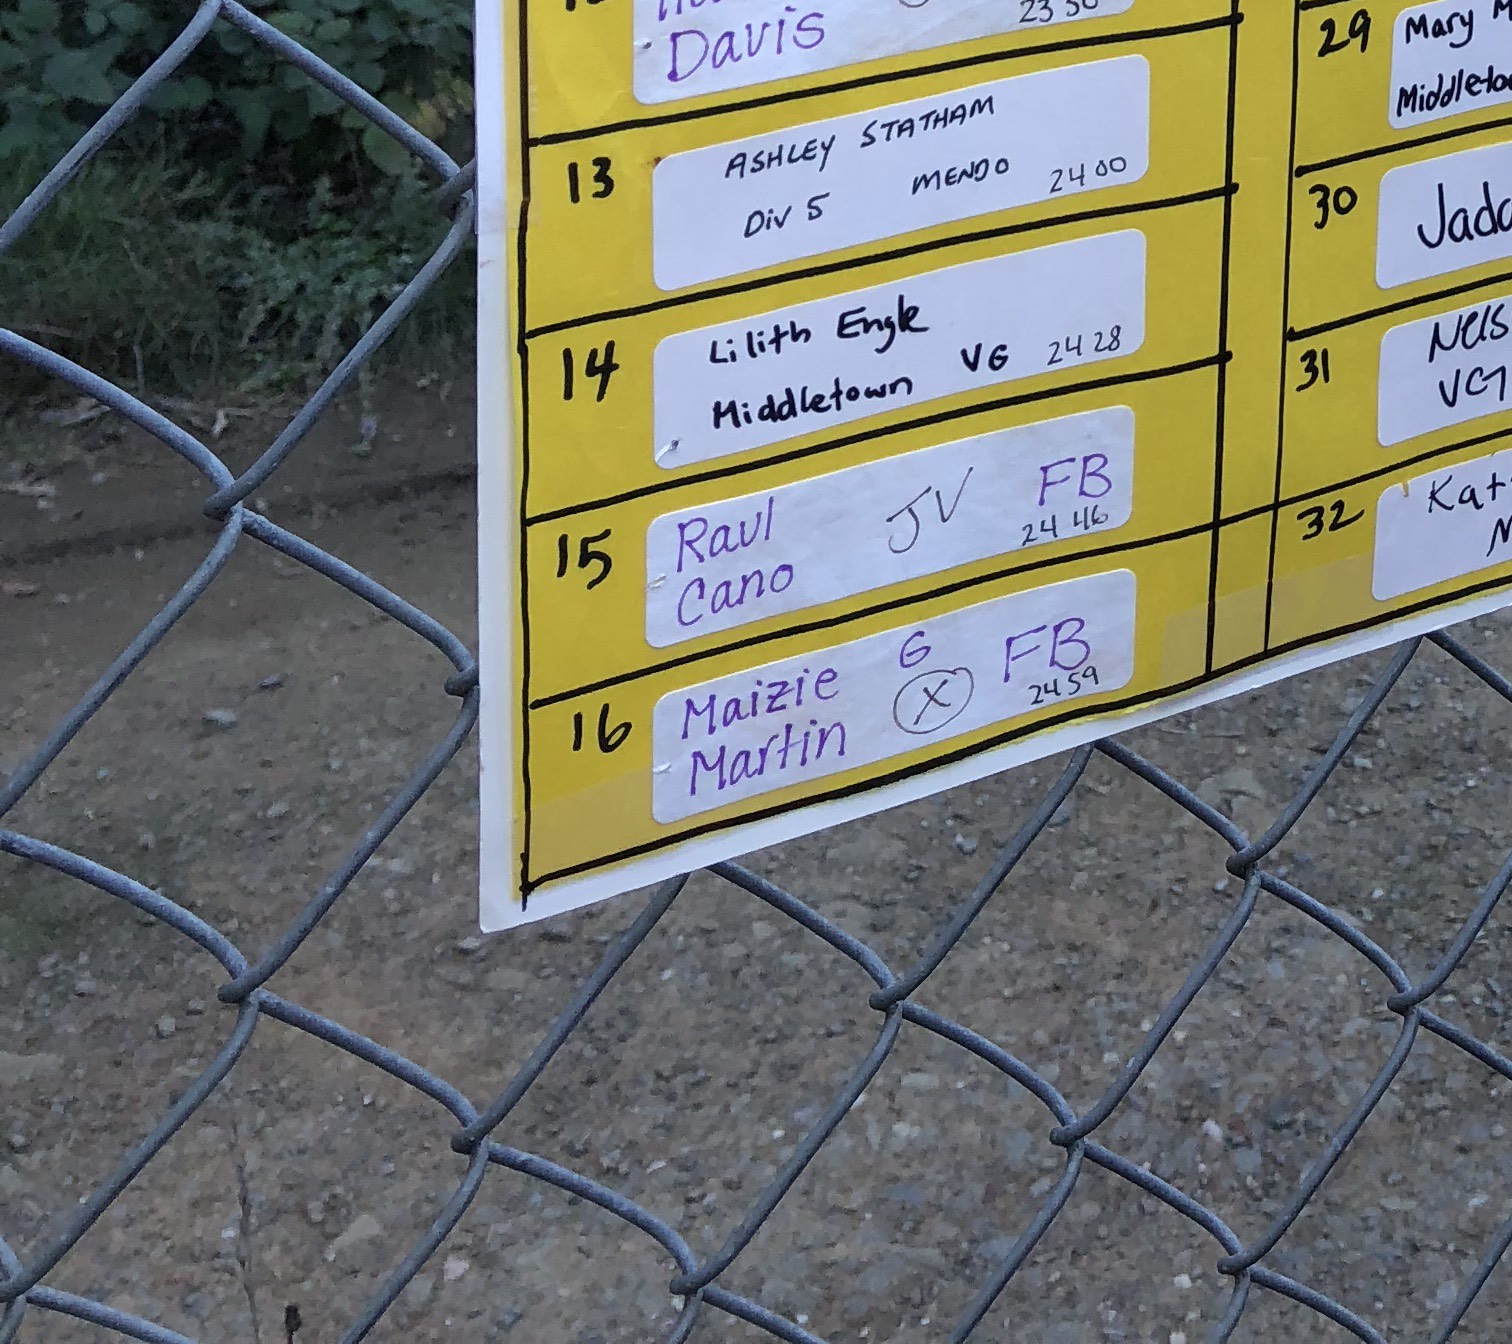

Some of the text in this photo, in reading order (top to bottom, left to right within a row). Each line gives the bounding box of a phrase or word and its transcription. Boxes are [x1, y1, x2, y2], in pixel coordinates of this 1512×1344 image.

[667, 6, 824, 82] Davis
[1318, 9, 1371, 57] 29
[1406, 9, 1473, 48] Mary
[725, 95, 994, 178] ASHLEY STATHAM
[567, 157, 615, 204] 13
[912, 158, 1009, 195] MENDO
[1309, 184, 1358, 229] 30
[709, 321, 811, 364] Lilith
[712, 377, 913, 429] Middletown
[677, 453, 1112, 573] Raul FB
[1297, 499, 1365, 541] 32
[557, 529, 612, 590] 15
[678, 564, 793, 626] Cano
[573, 706, 632, 753] 16
[682, 668, 841, 741] Maizie
[688, 716, 846, 796] Martin
